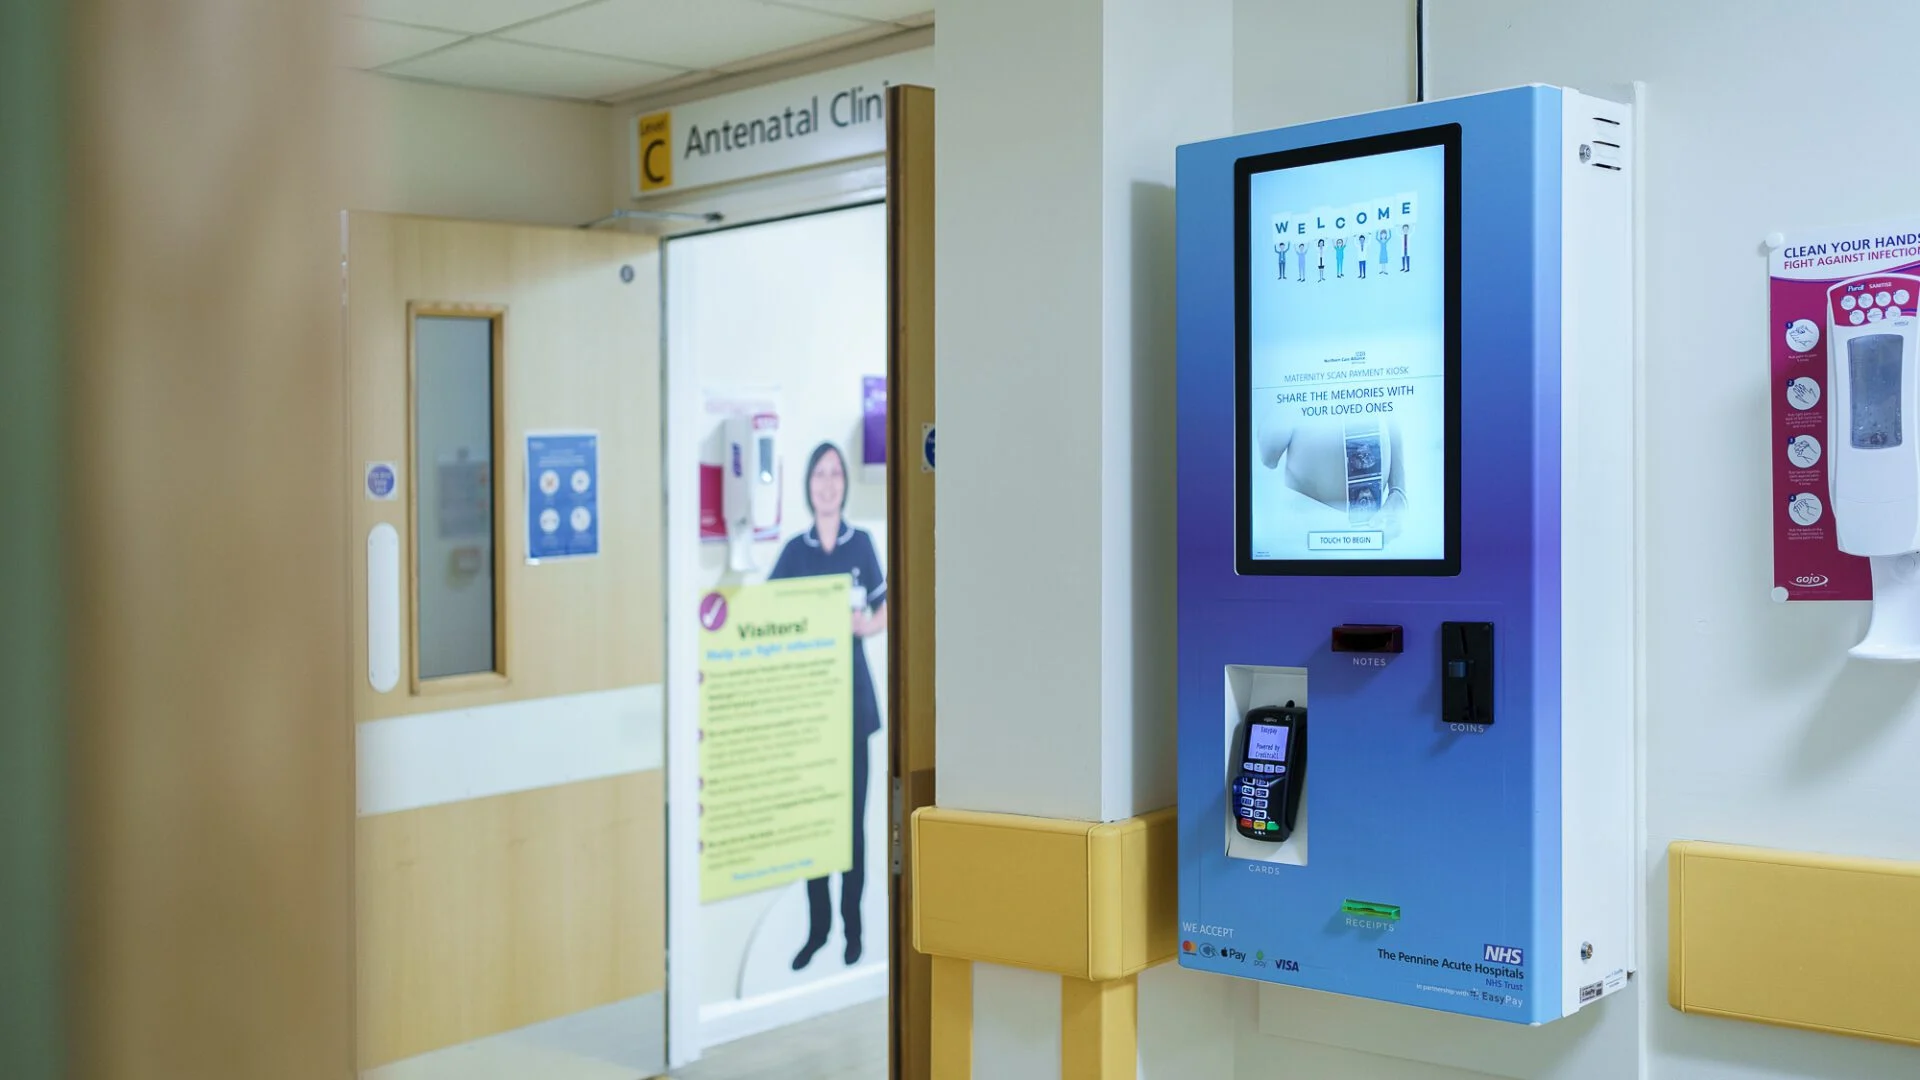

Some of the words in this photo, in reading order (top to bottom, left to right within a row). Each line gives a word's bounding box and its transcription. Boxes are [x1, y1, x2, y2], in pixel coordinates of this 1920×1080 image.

[683, 95, 819, 159] Antenatal
[643, 138, 666, 184] C
[1275, 201, 1411, 235] WELCOME
[1784, 243, 1827, 258] CLEAN
[1831, 238, 1871, 253] YOUR
[1784, 258, 1815, 270] FIGHT
[1817, 252, 1866, 266] AGAINST
[1284, 371, 1325, 383] MATERNITY
[1327, 370, 1347, 380] SCAN
[1349, 367, 1384, 378] PAYMENT
[1386, 366, 1409, 376] KIOSK
[1276, 392, 1307, 404] SHARE
[1309, 390, 1328, 401] THE
[1330, 386, 1385, 400] MEMORIES
[1387, 385, 1415, 397] WITH
[1301, 405, 1328, 417] YOUR
[1330, 403, 1363, 415] LOVED
[1365, 401, 1394, 413] ONES
[1320, 536, 1342, 545] TOUCH
[1342, 535, 1352, 544] TO
[1352, 535, 1371, 544] BEGIN
[1352, 657, 1386, 667] NOTES
[1450, 723, 1484, 733] COINS
[1248, 864, 1280, 876] CARDS
[1182, 921, 1198, 933] WE
[1199, 923, 1235, 938] ACCEPT
[1345, 917, 1395, 932] RECEIPTS
[1229, 948, 1247, 962] Pay
[1485, 945, 1522, 965] NHS
[1275, 959, 1299, 972] VISA
[1377, 948, 1396, 961] The
[1398, 951, 1439, 967] Pennine
[1441, 954, 1472, 972] Acute
[1475, 963, 1524, 980] Hospitals
[1423, 984, 1455, 996] partnership
[1485, 978, 1502, 988] NHS
[1504, 980, 1524, 991] Trust
[1482, 991, 1523, 1008] EasyPay
